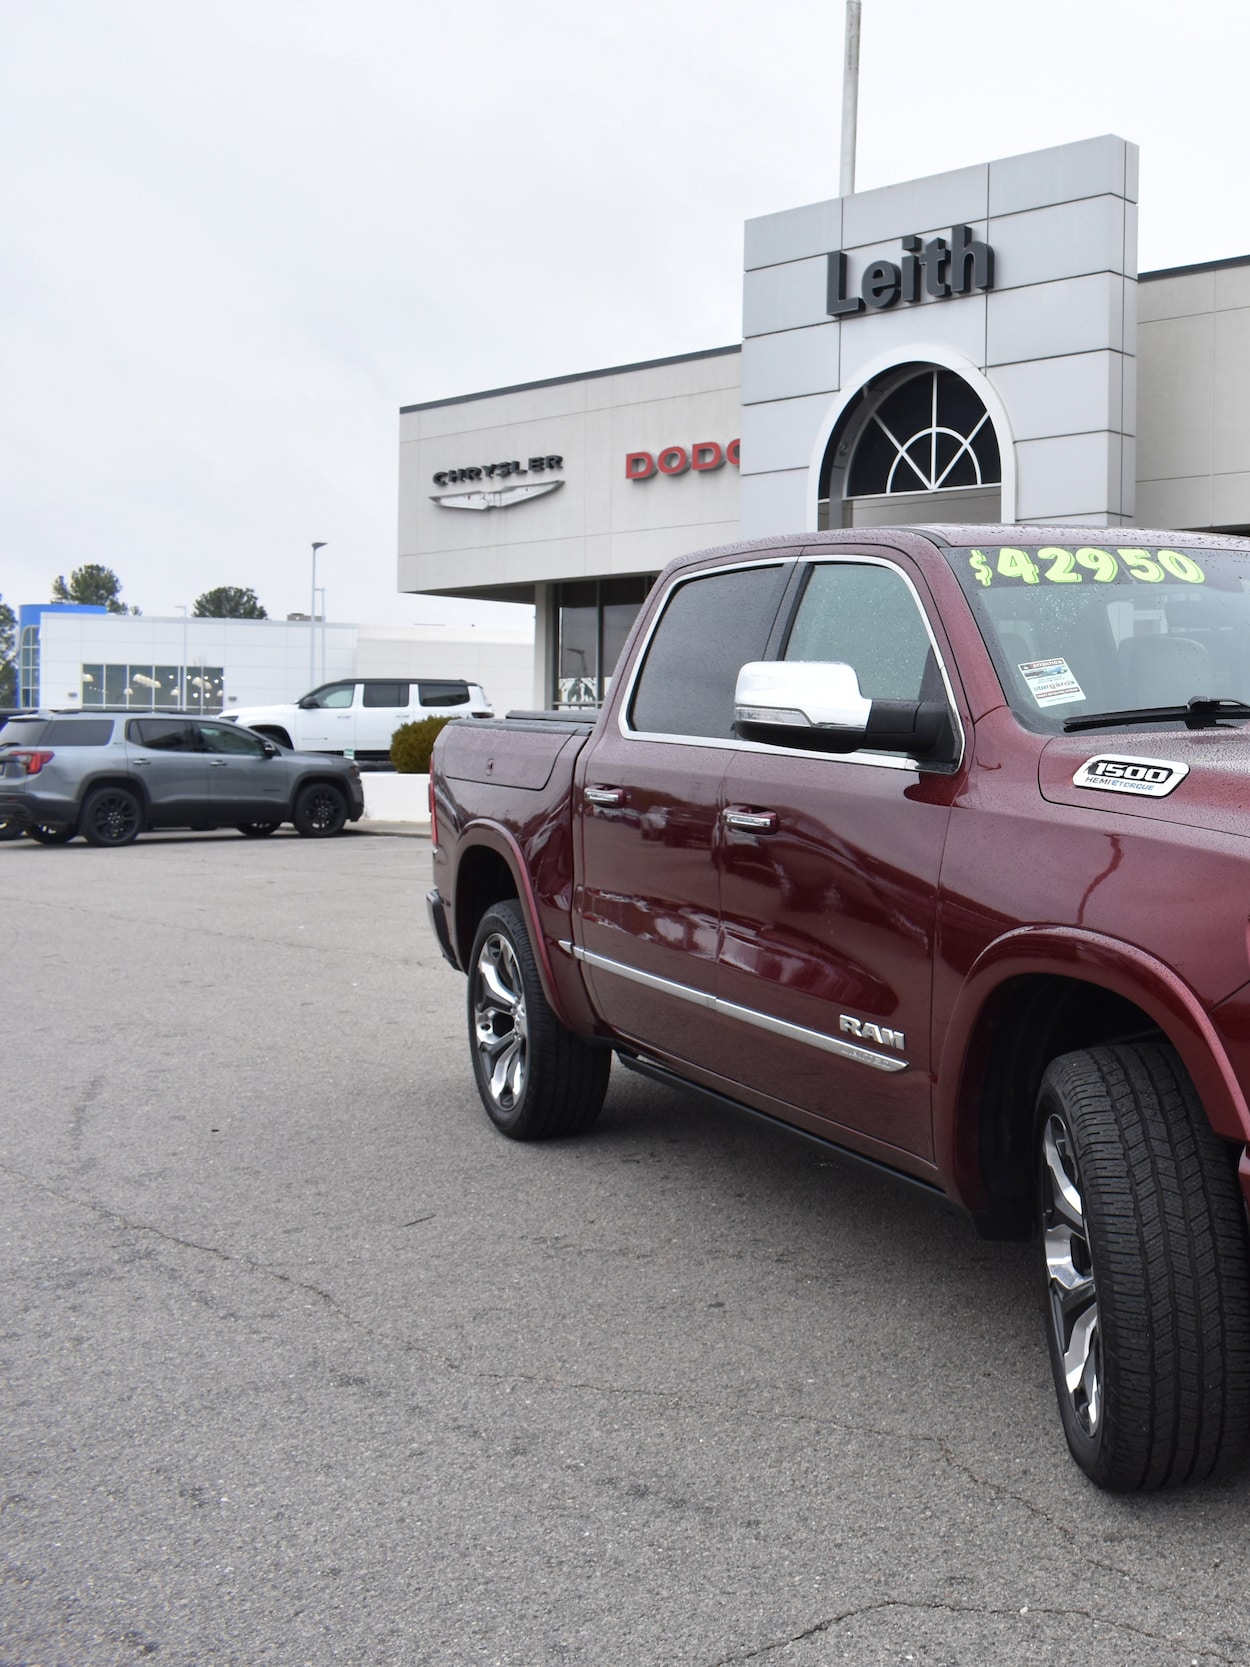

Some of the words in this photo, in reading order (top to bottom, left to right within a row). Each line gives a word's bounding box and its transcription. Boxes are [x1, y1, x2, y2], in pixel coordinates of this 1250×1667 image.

[826, 225, 995, 317] Leith
[433, 454, 564, 486] CHRYSLER
[969, 547, 1205, 587] $42950
[1085, 776, 1111, 786] HEMI
[1095, 762, 1170, 783] 1500
[839, 1014, 905, 1051] RAM
